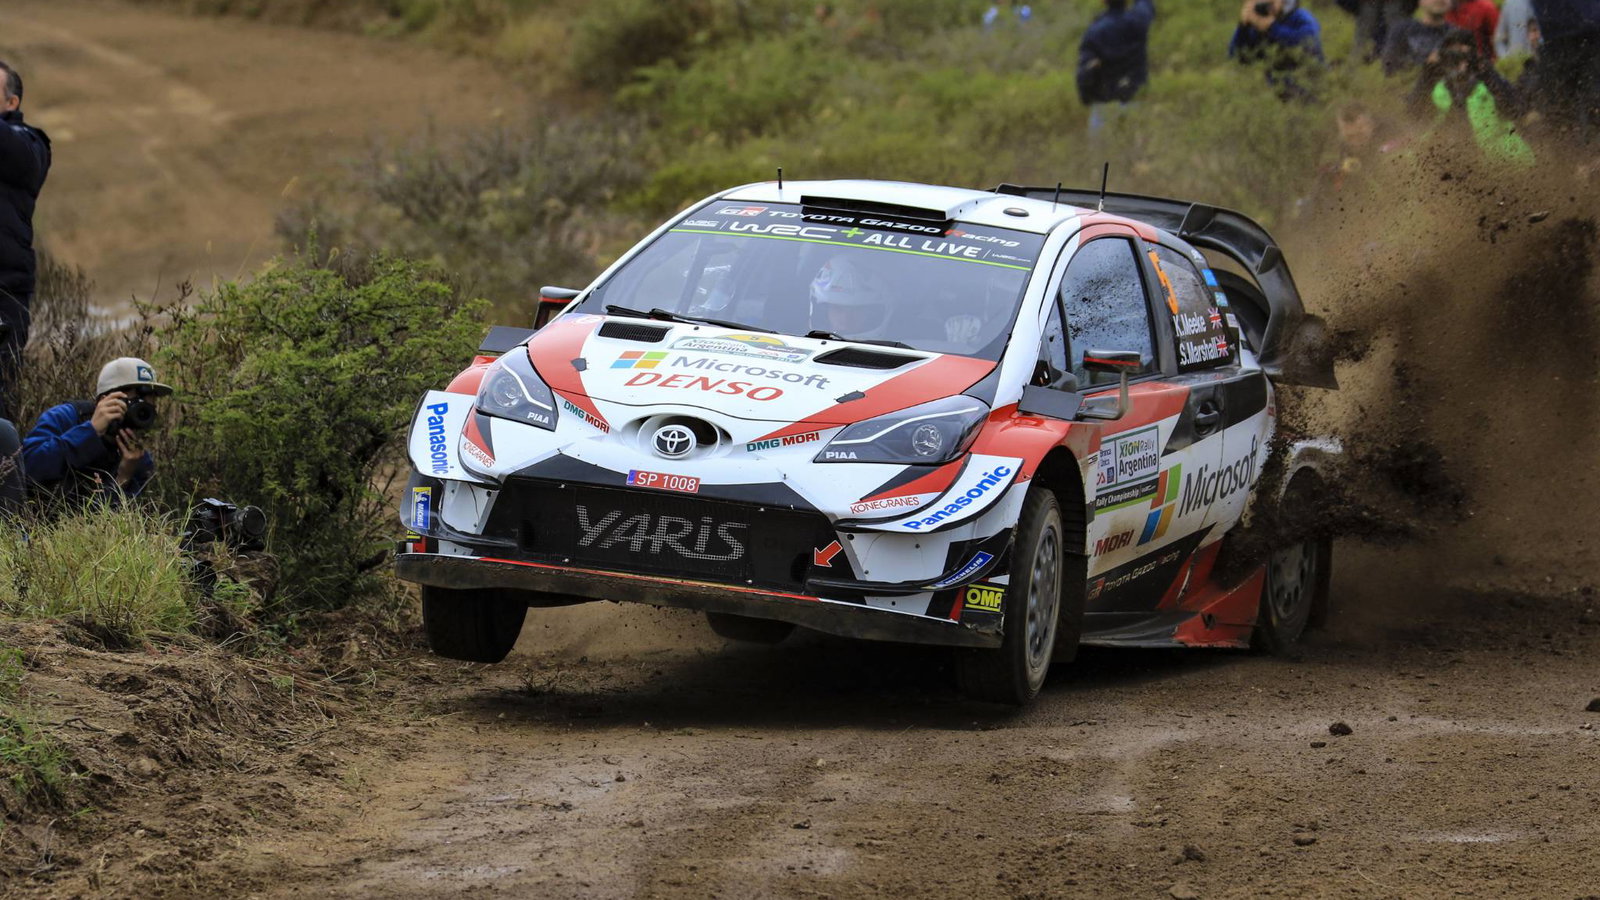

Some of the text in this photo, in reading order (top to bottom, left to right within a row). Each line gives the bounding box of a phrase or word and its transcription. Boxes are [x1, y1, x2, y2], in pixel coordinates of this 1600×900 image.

[768, 210, 853, 224] TOYOTA
[859, 218, 941, 234] GAZOO
[945, 229, 1020, 247] Racing
[863, 232, 912, 249] ALL
[921, 238, 982, 258] LIVE
[1172, 312, 1206, 337] K.Meeke
[682, 342, 748, 352] Argentina
[1180, 336, 1220, 366] S.Marshall
[670, 355, 831, 390] Microsoft
[624, 372, 784, 401] DENSO
[527, 411, 549, 425] PIAA
[563, 400, 610, 434] DMG MORI
[426, 402, 454, 475] Panasonic
[746, 432, 820, 451] DMG MORI
[1119, 440, 1140, 458] XION
[825, 451, 857, 460] PIAA
[1119, 452, 1157, 477] Argentina
[637, 472, 696, 491] SP 1008
[1178, 434, 1258, 519] Microsoft
[850, 496, 920, 515] KONECRANES
[903, 465, 1011, 530] Panasonic
[1094, 529, 1135, 557] MORI
[966, 588, 1003, 607] OMP
